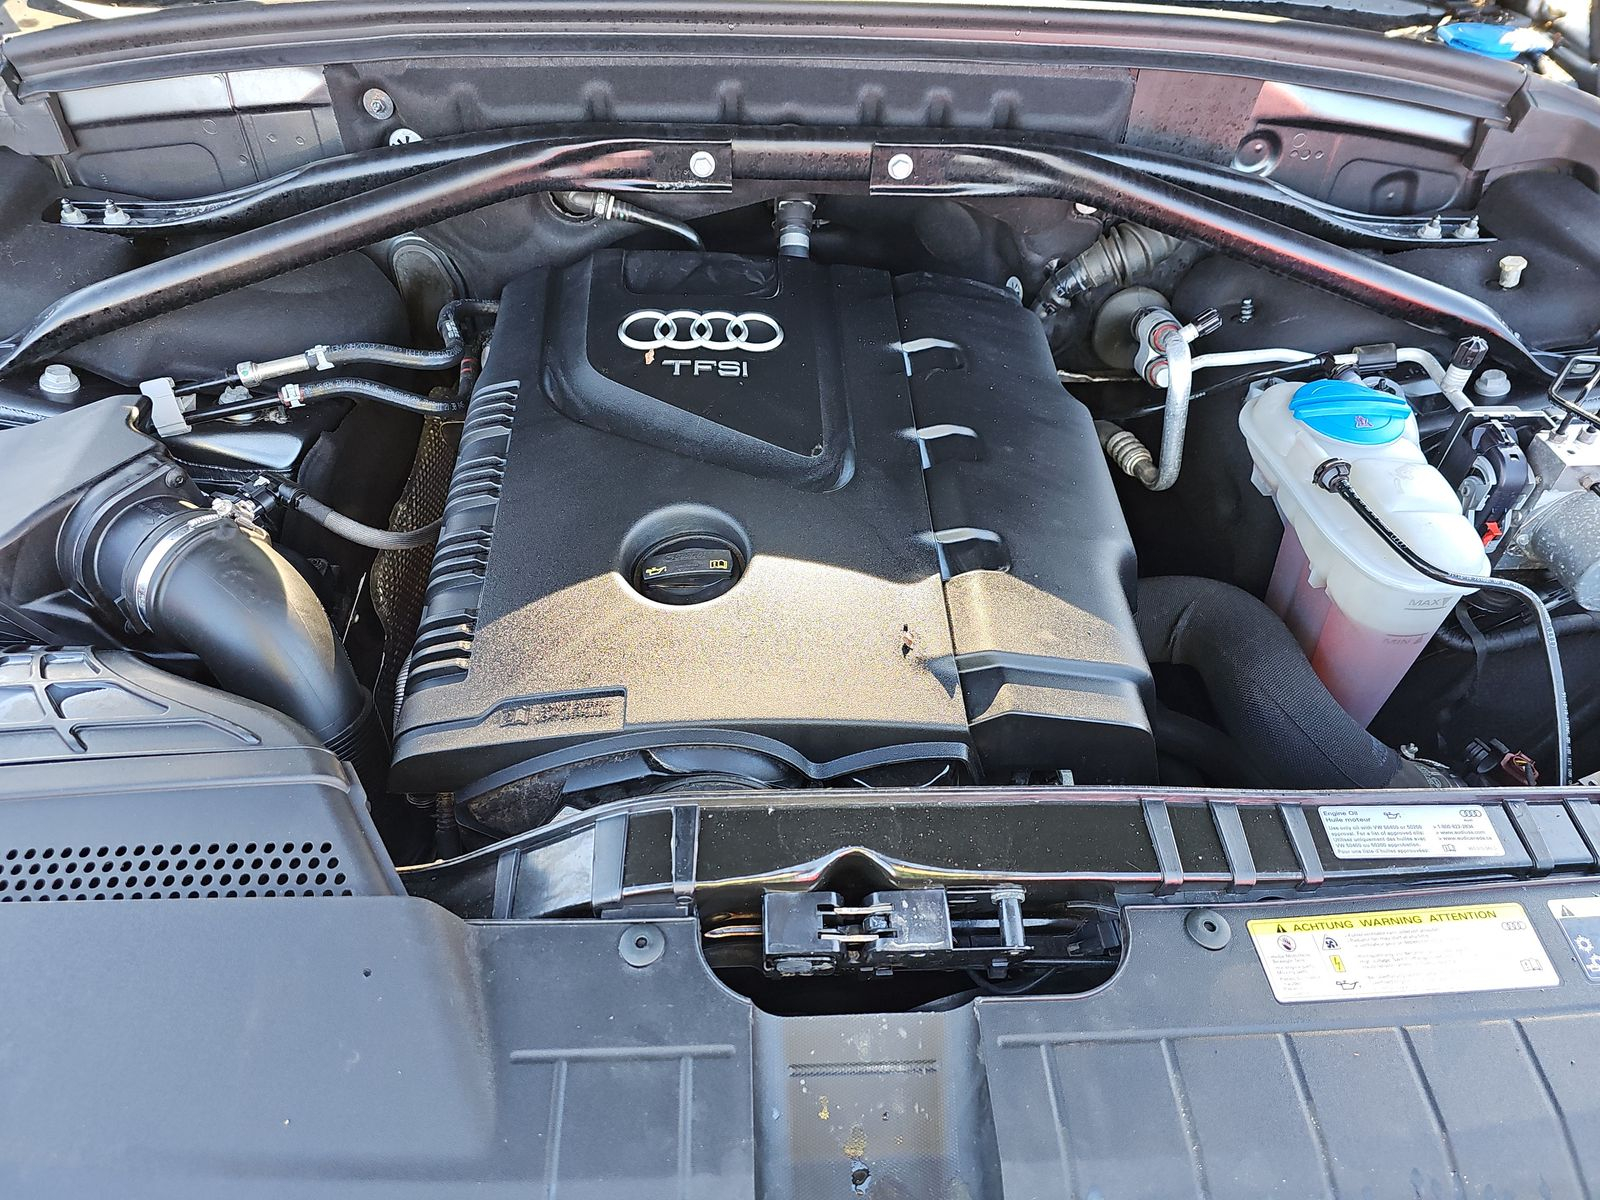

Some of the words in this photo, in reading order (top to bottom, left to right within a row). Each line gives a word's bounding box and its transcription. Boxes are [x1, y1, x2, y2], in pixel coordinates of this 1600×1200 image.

[661, 359, 749, 378] TFSI
[1408, 598, 1442, 606] MAX
[1293, 920, 1354, 932] ACHTUNG
[1359, 914, 1423, 927] WARNING
[1429, 910, 1498, 922] ATTENTION
